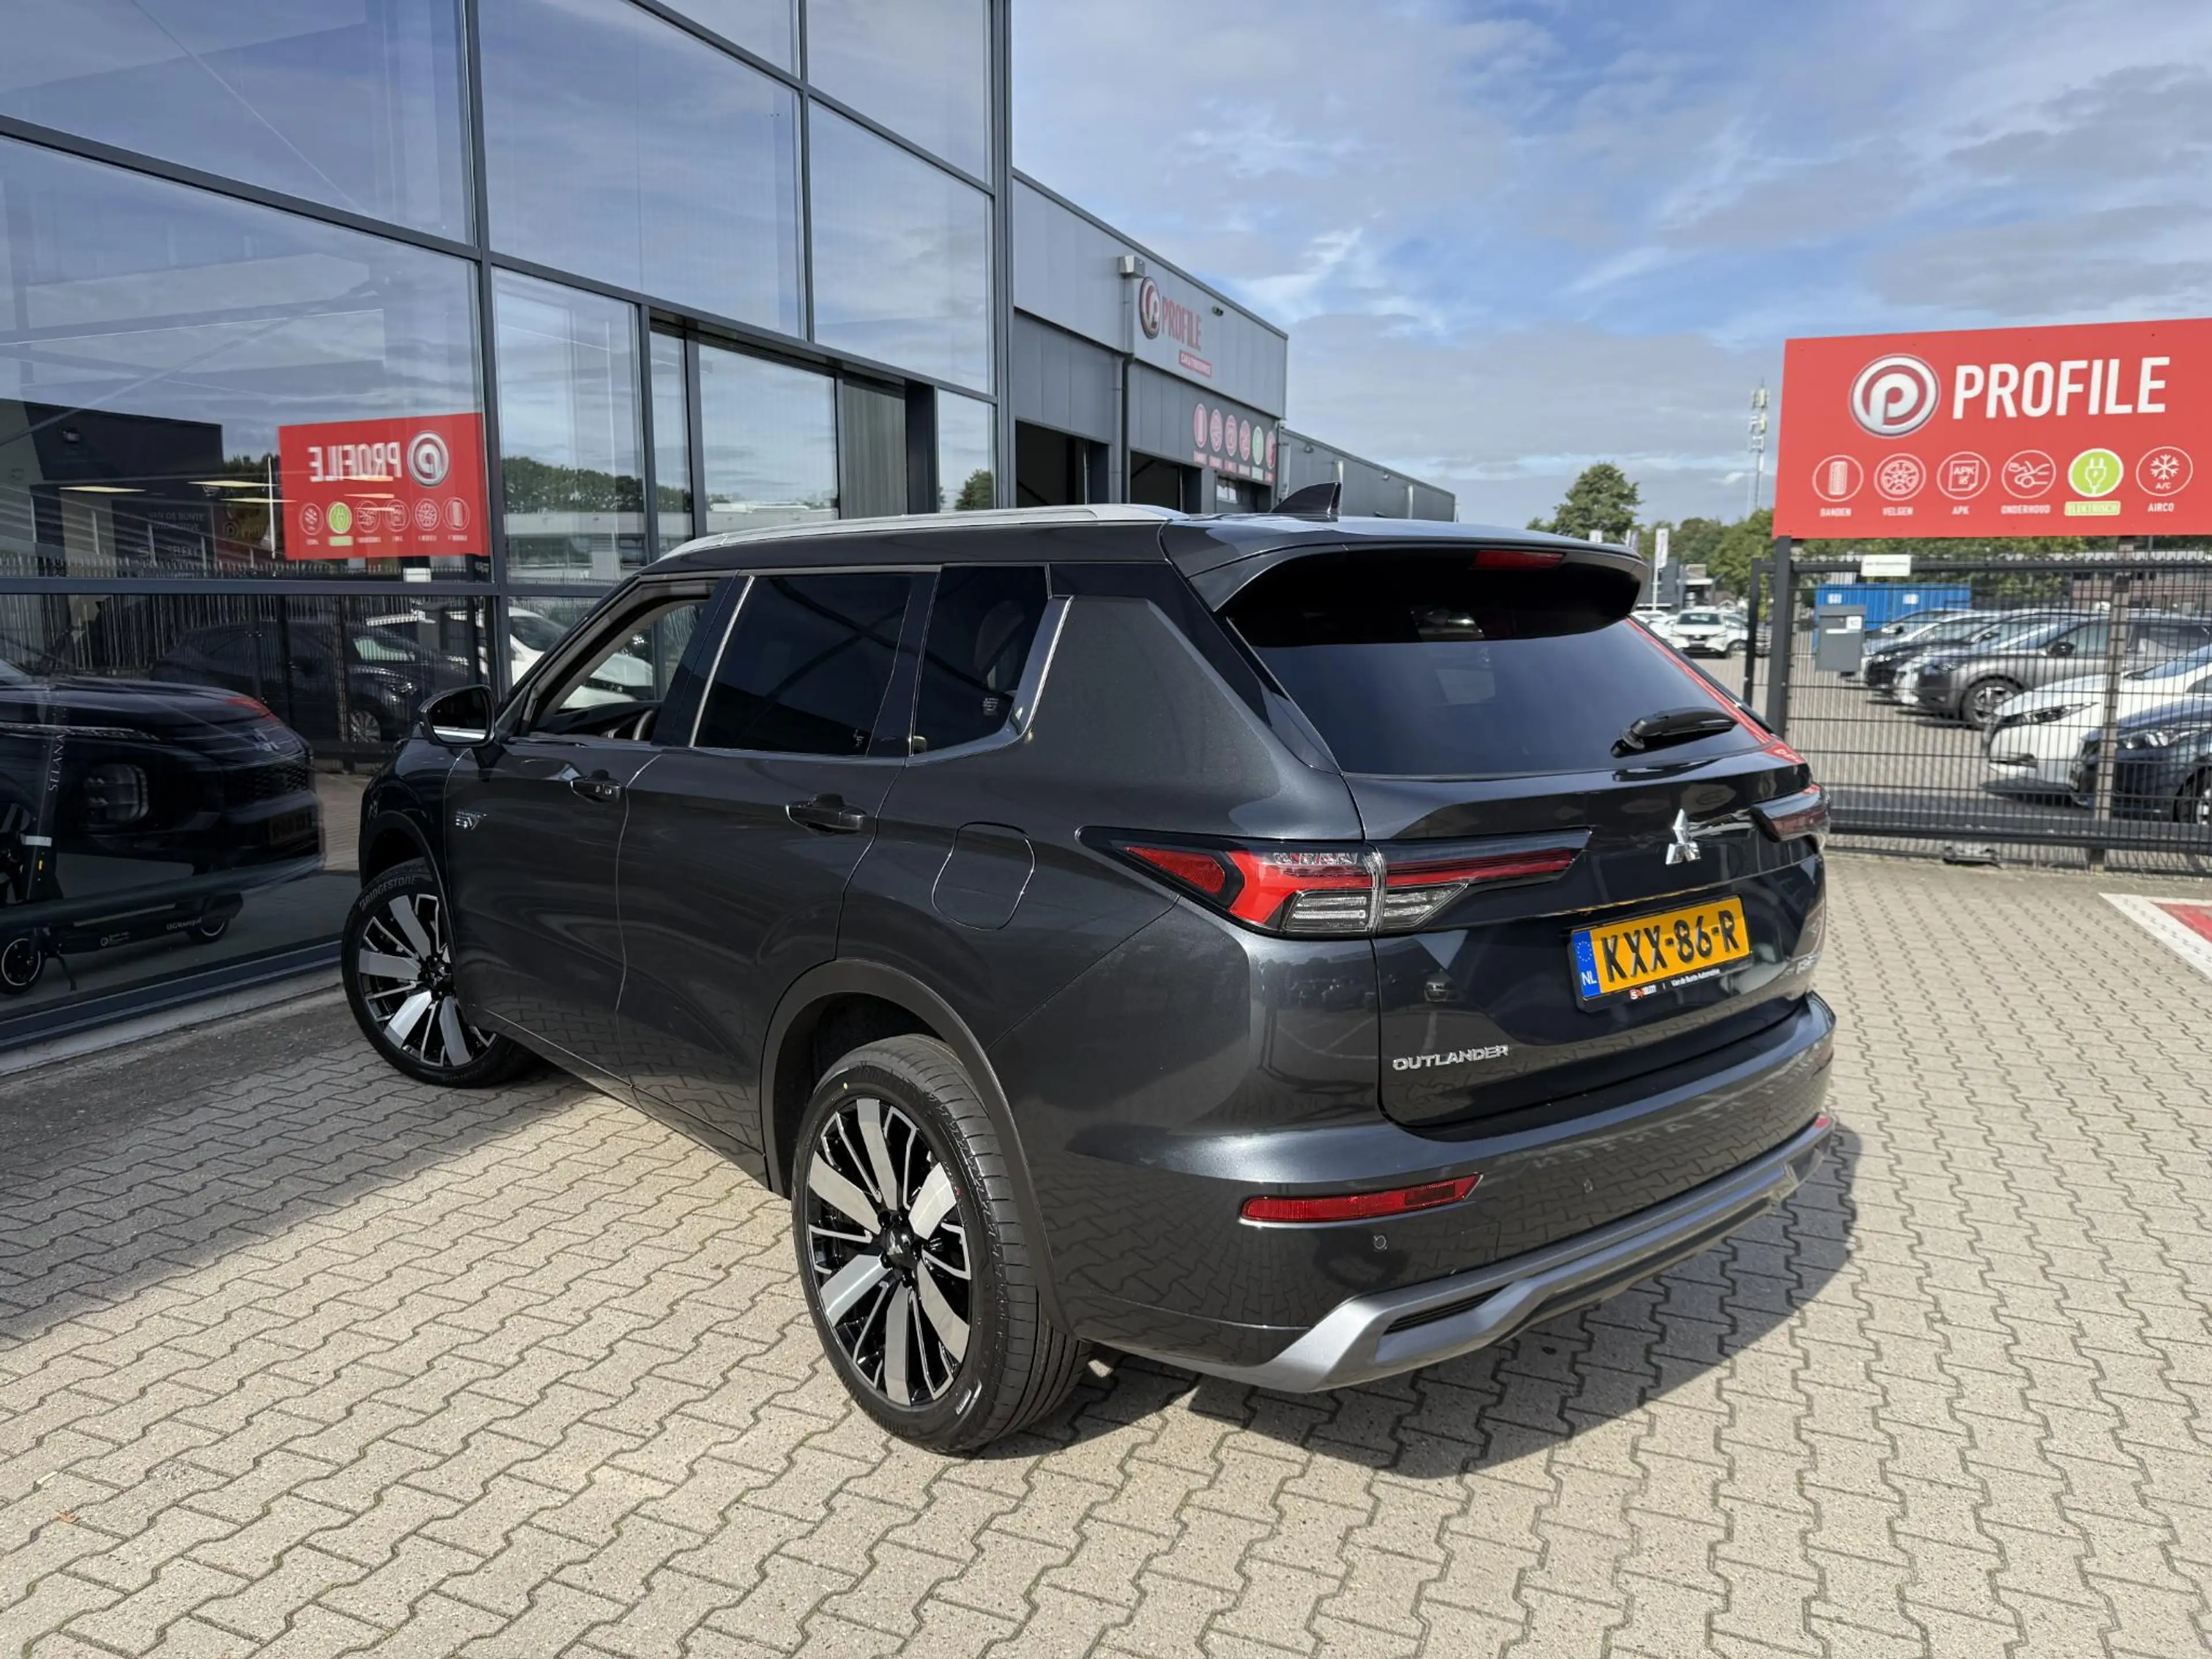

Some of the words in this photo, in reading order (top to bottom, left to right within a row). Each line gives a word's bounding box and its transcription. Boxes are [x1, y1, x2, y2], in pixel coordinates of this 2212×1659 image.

[1161, 296, 1202, 352] PROFILE
[1952, 356, 2171, 420] PROFILE
[1820, 507, 1852, 517] BANDEN
[1882, 506, 1914, 516] VELGEN
[1952, 506, 1970, 515] APK
[2001, 504, 2051, 514] ONDERHOUD
[2147, 502, 2175, 513] AIRCO
[1600, 909, 1740, 983] KXX-86-R
[1582, 970, 1597, 986] NL
[1392, 1044, 1509, 1071] OUTLANDER
